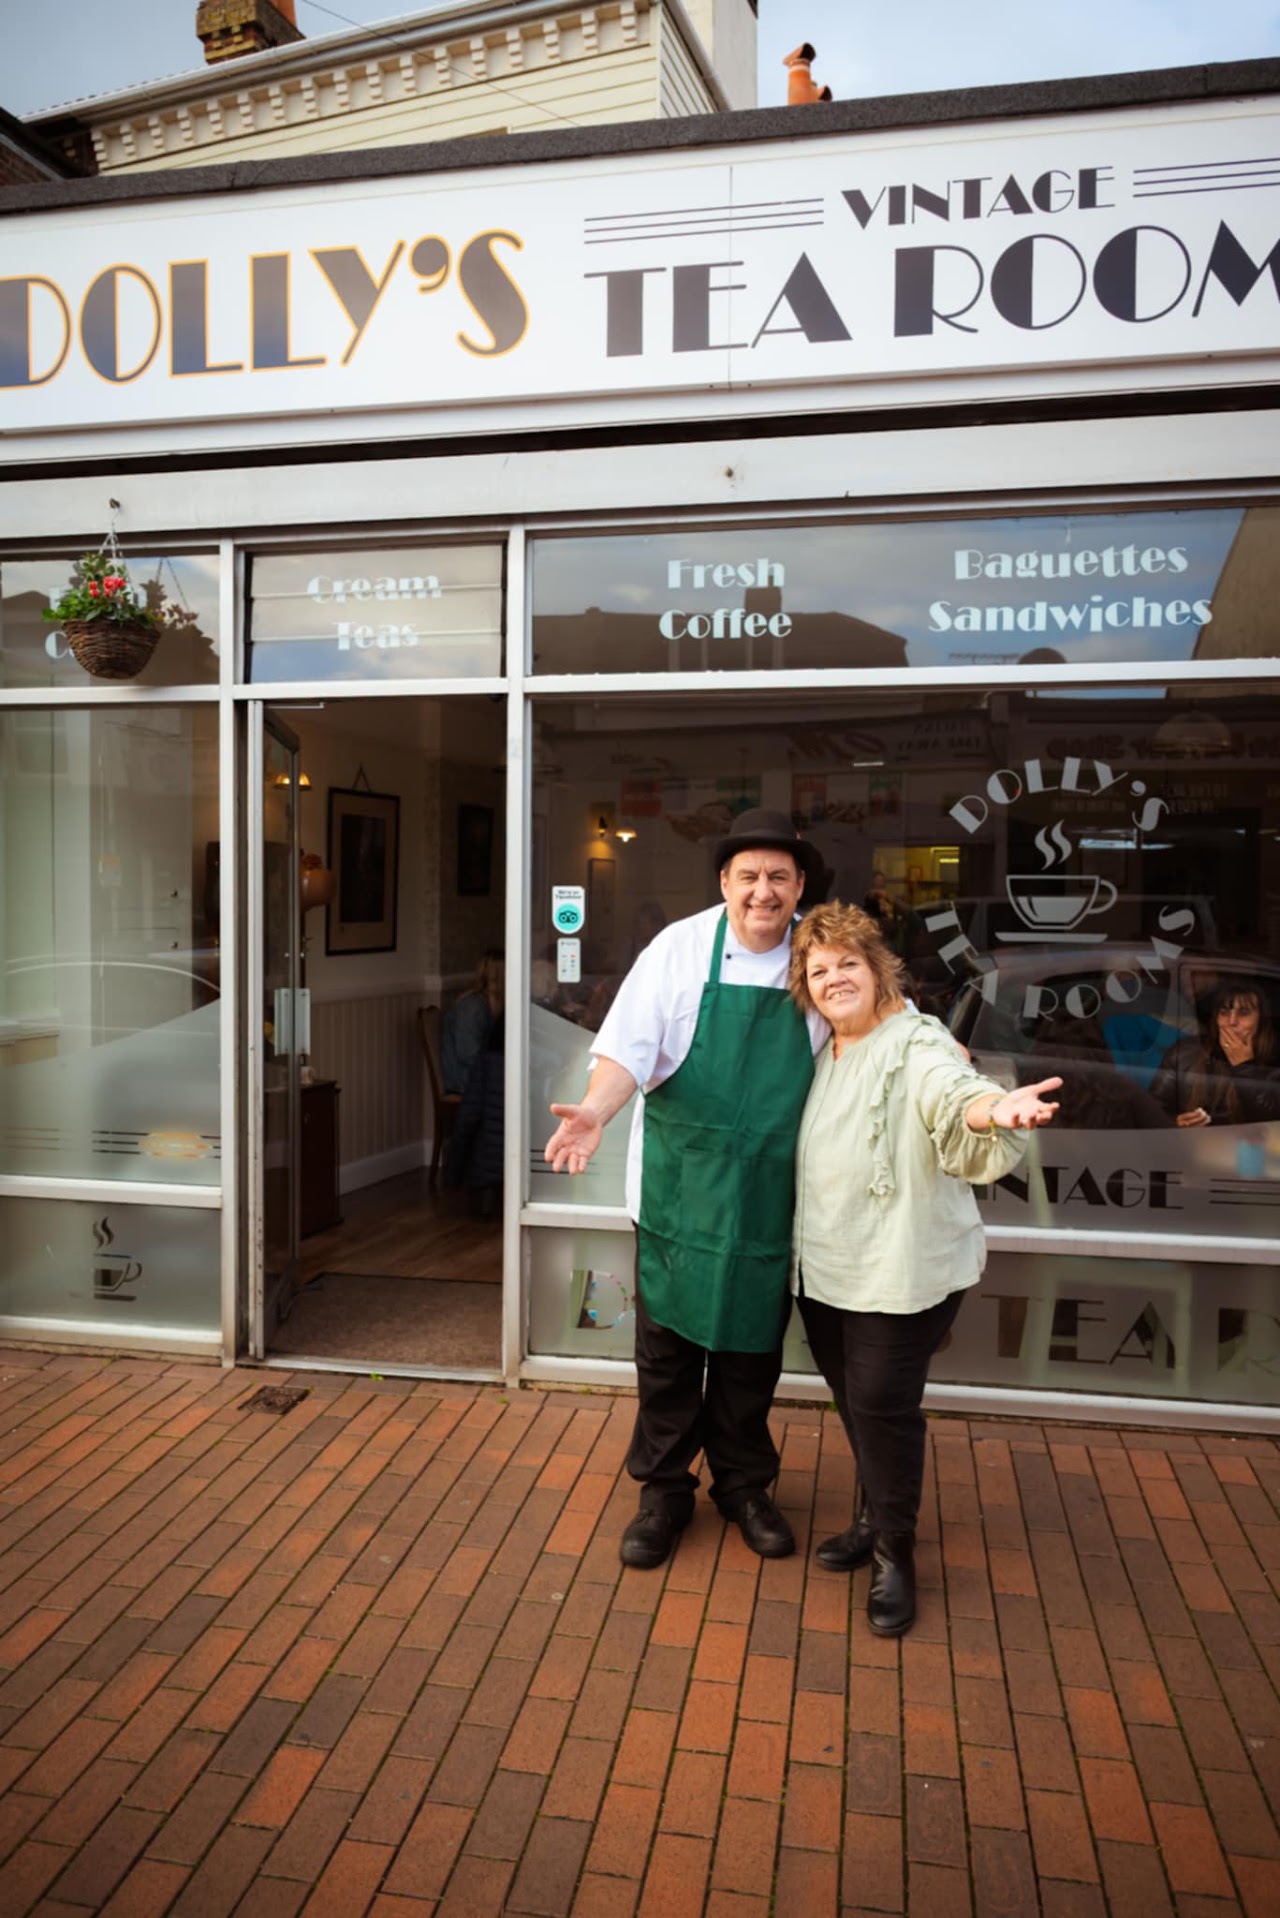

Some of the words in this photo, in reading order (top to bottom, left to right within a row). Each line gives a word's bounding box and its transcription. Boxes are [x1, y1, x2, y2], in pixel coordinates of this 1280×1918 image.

[841, 165, 1115, 231] VINTAGE
[0, 227, 531, 391] DOLLY'S
[583, 251, 854, 357] TEA
[306, 570, 443, 605] Cream
[666, 556, 786, 590] Fresh
[953, 543, 1190, 581] Baguettes
[333, 619, 419, 652] Teas
[658, 607, 793, 640] Coffee
[927, 594, 1213, 634] Sandwiches
[948, 756, 1170, 834] DOLLY'S
[924, 900, 999, 1007] TEA
[1022, 904, 1196, 1022] ROOMS
[972, 1165, 1185, 1210] NTAGE
[981, 1293, 1178, 1370] TEA
